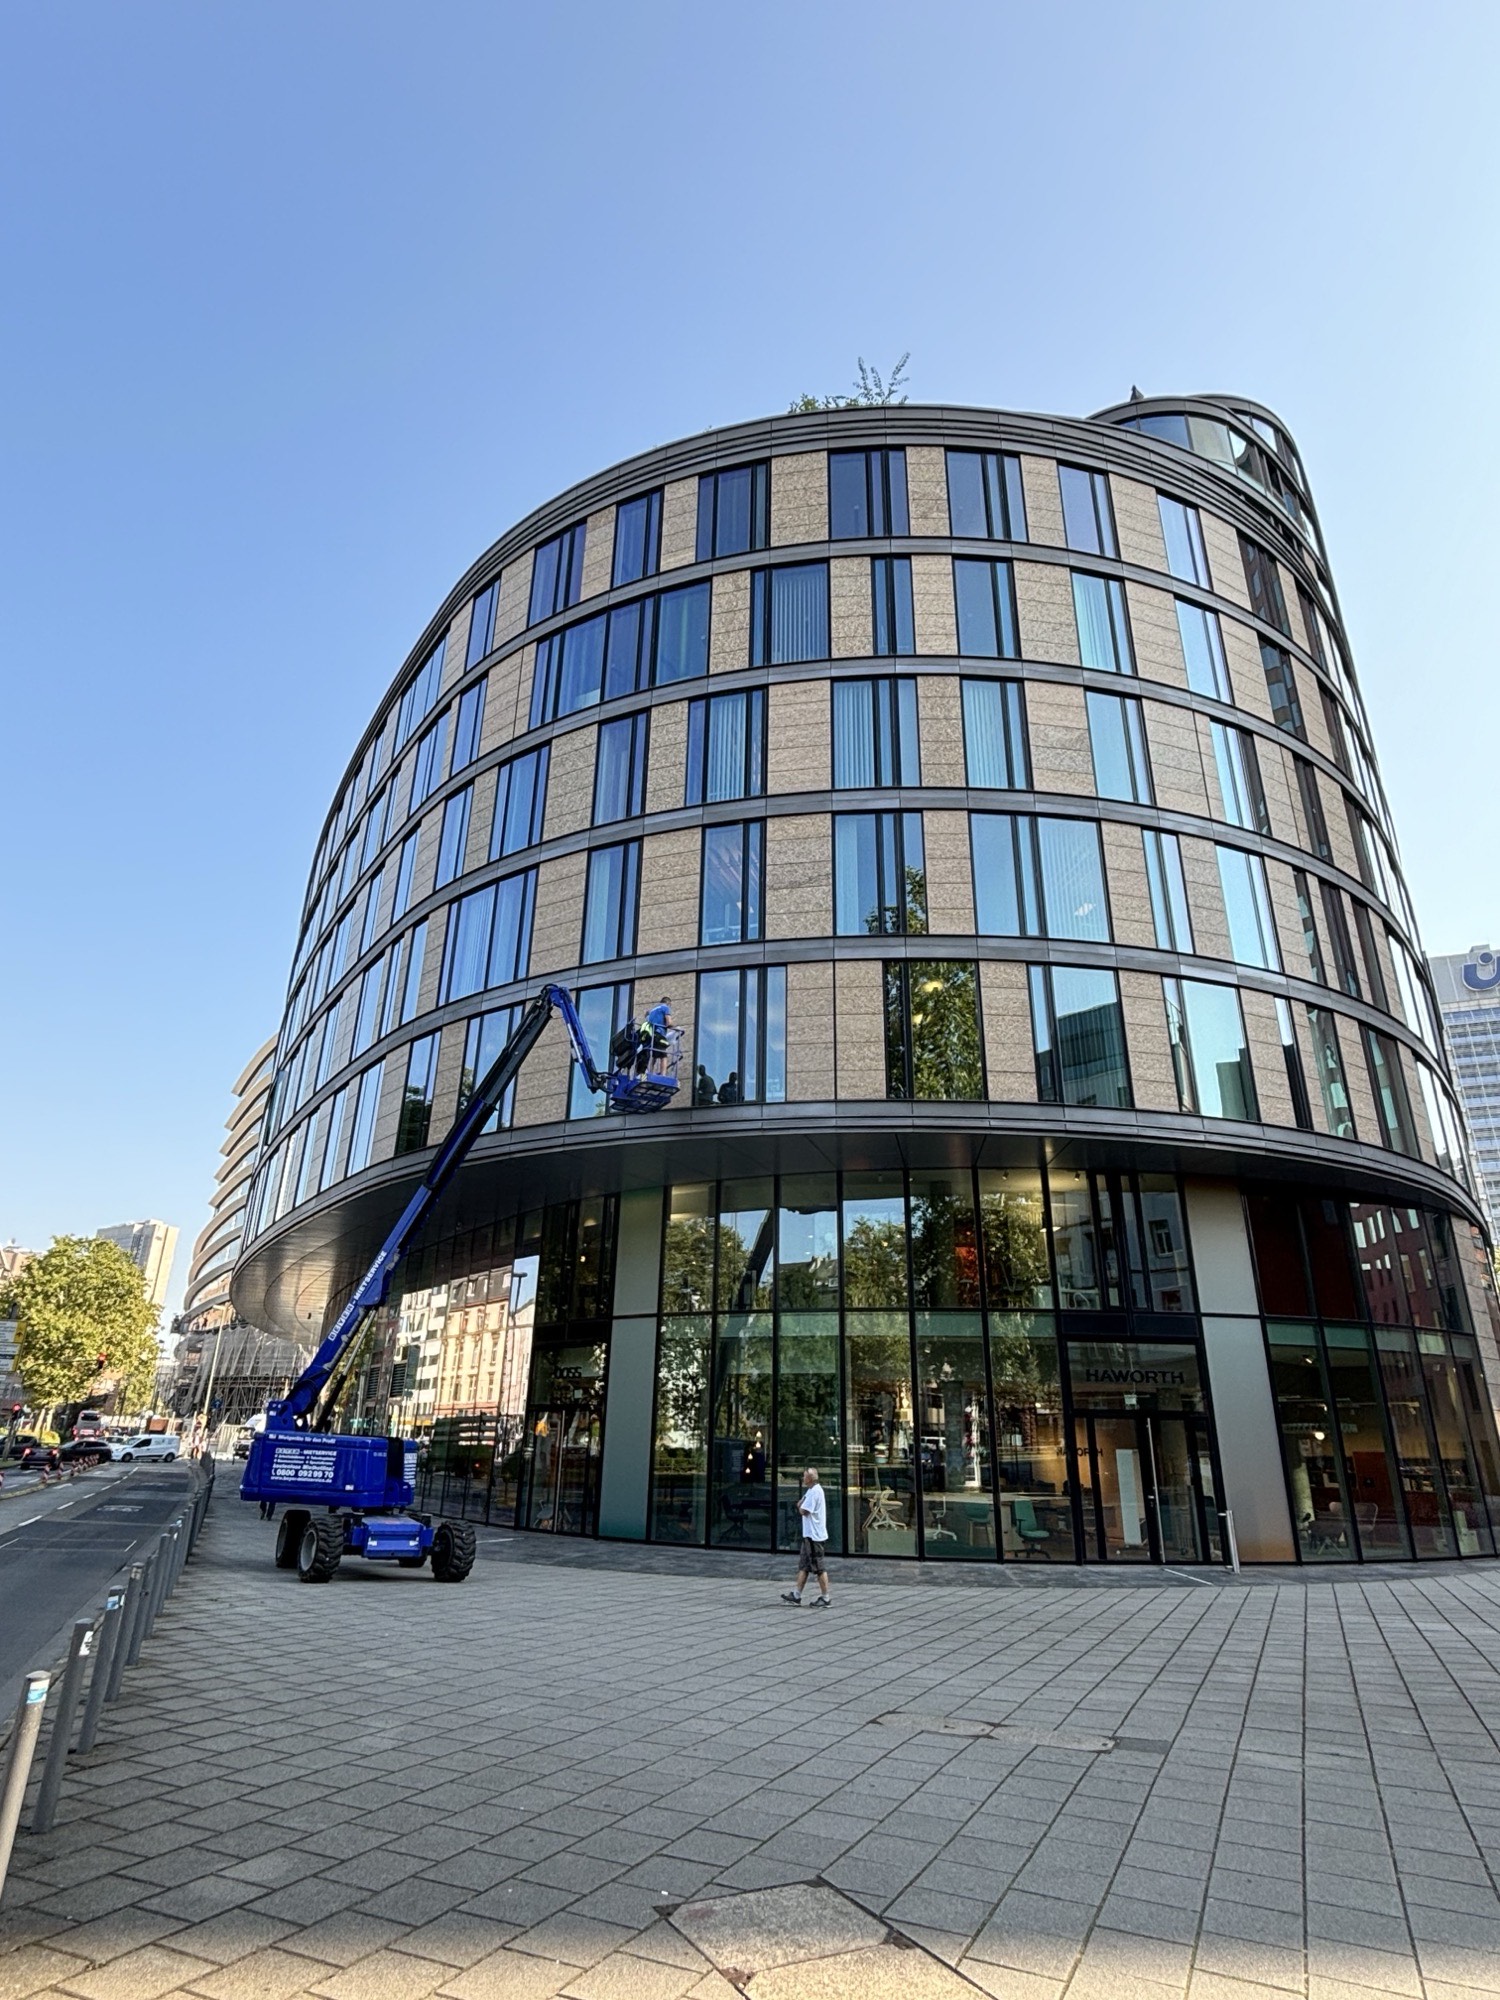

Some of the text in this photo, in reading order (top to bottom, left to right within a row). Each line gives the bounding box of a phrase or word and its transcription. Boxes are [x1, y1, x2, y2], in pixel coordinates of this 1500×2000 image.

[328, 1303, 355, 1342] BEYER
[354, 1250, 387, 1300] MIETSERVICE
[1086, 1369, 1185, 1384] HAWORTH
